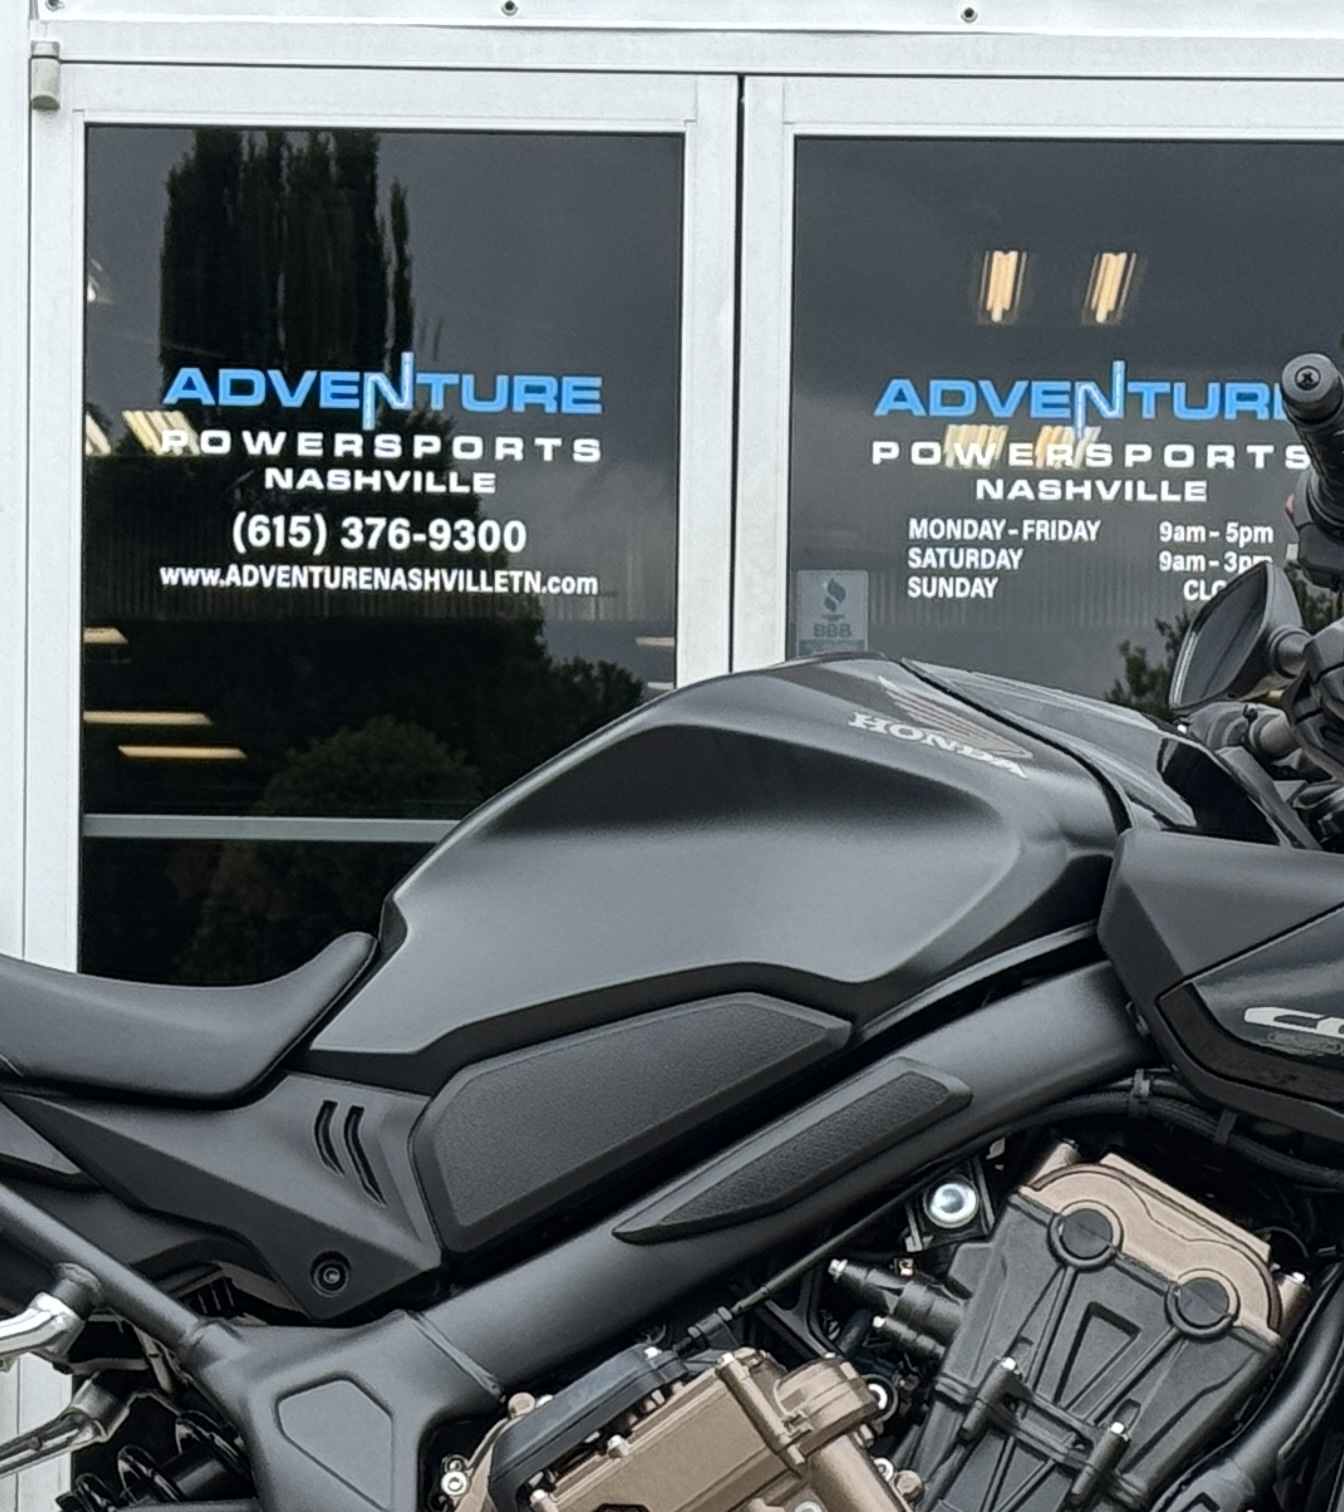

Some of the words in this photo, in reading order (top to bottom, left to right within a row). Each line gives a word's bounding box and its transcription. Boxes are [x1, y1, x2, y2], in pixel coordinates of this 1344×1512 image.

[162, 352, 603, 430] ADVENTURE
[873, 360, 1288, 439] ADVENTUR
[160, 430, 602, 462] POWERSPORTS
[872, 441, 1311, 469] POWERSPORTS
[265, 468, 496, 493] NASHVILLE
[975, 478, 1208, 502] NASHVILLE
[232, 513, 327, 555] (615)
[340, 517, 526, 554] 376-9300
[908, 548, 1024, 570] SATURDAY
[159, 563, 599, 596] www.ADVENTURENASHVILLETN.com
[907, 576, 999, 599] SUNDAY
[848, 711, 1030, 779] HONDA
